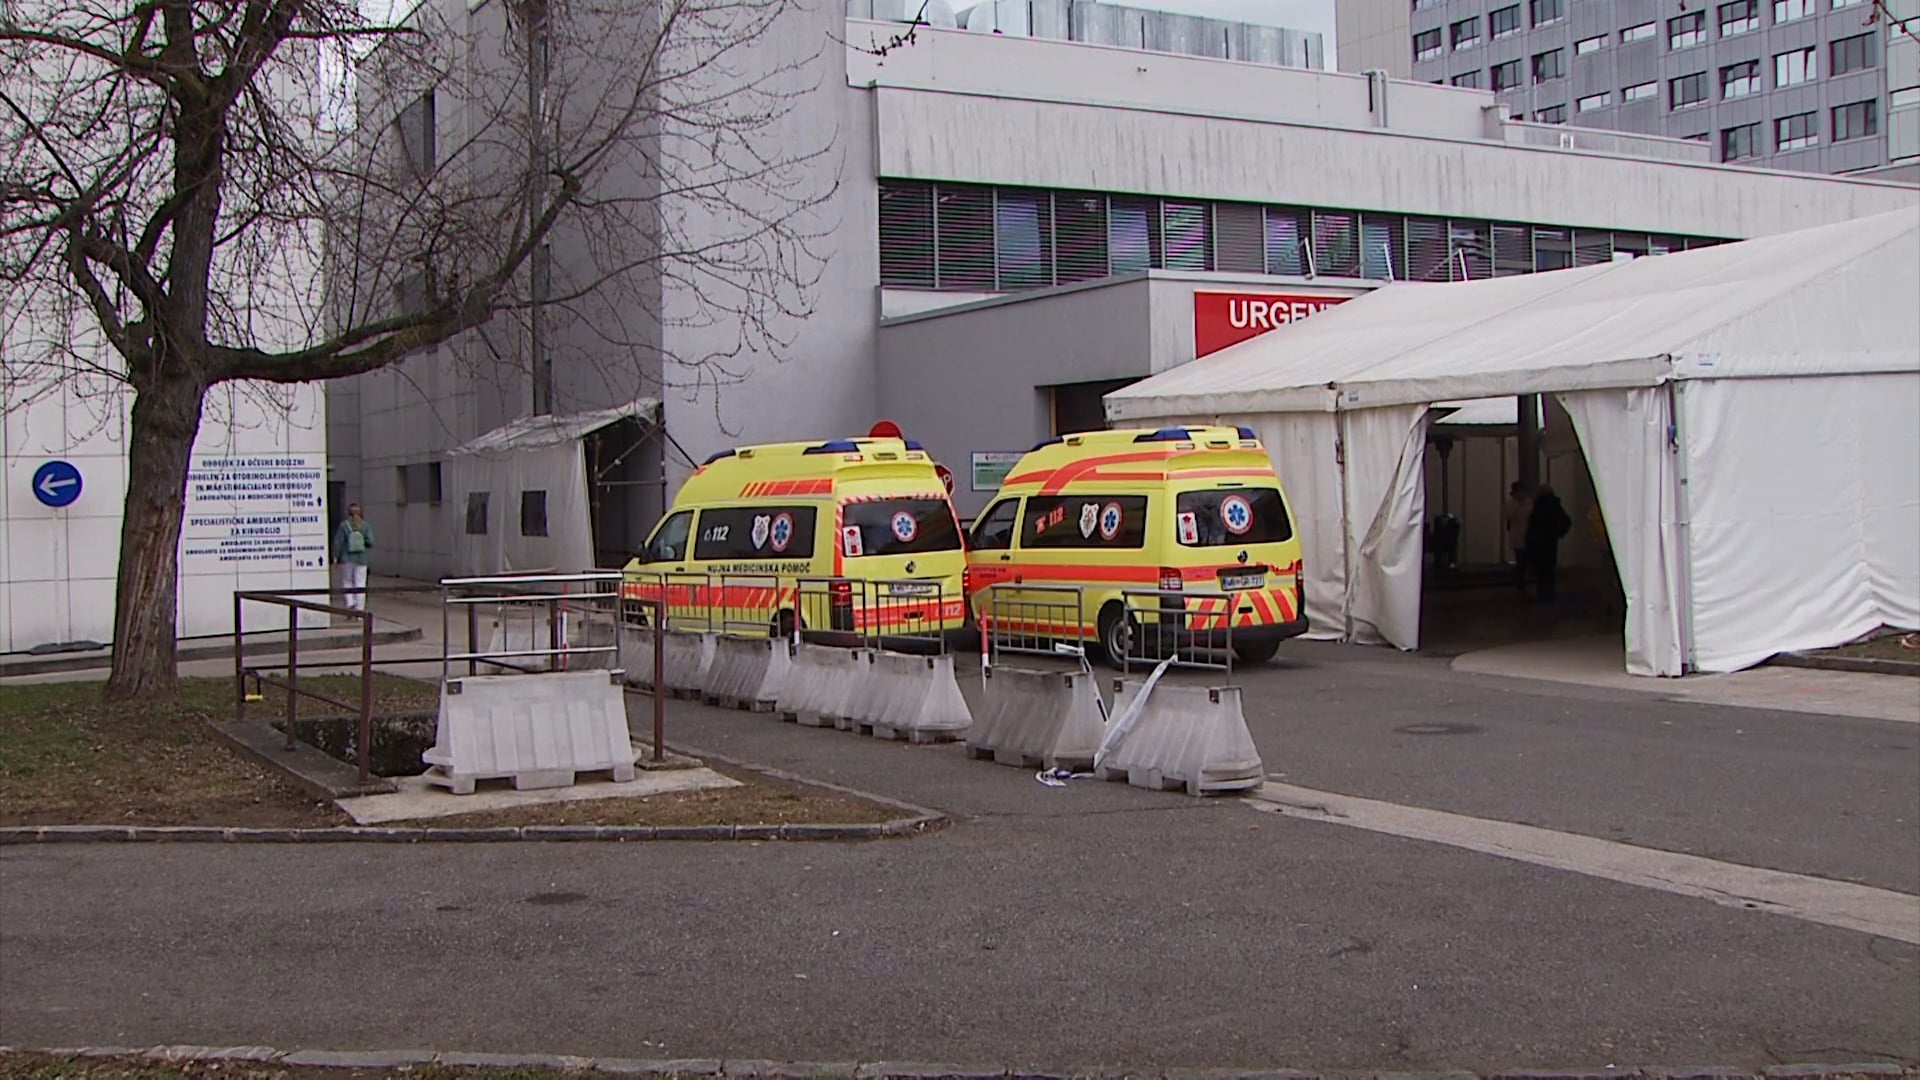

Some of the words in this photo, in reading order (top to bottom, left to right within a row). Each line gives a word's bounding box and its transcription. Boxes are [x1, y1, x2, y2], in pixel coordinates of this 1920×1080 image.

[1229, 298, 1326, 329] URGEN
[236, 459, 246, 467] ZA
[221, 472, 231, 481] ZA
[712, 525, 730, 542] 112
